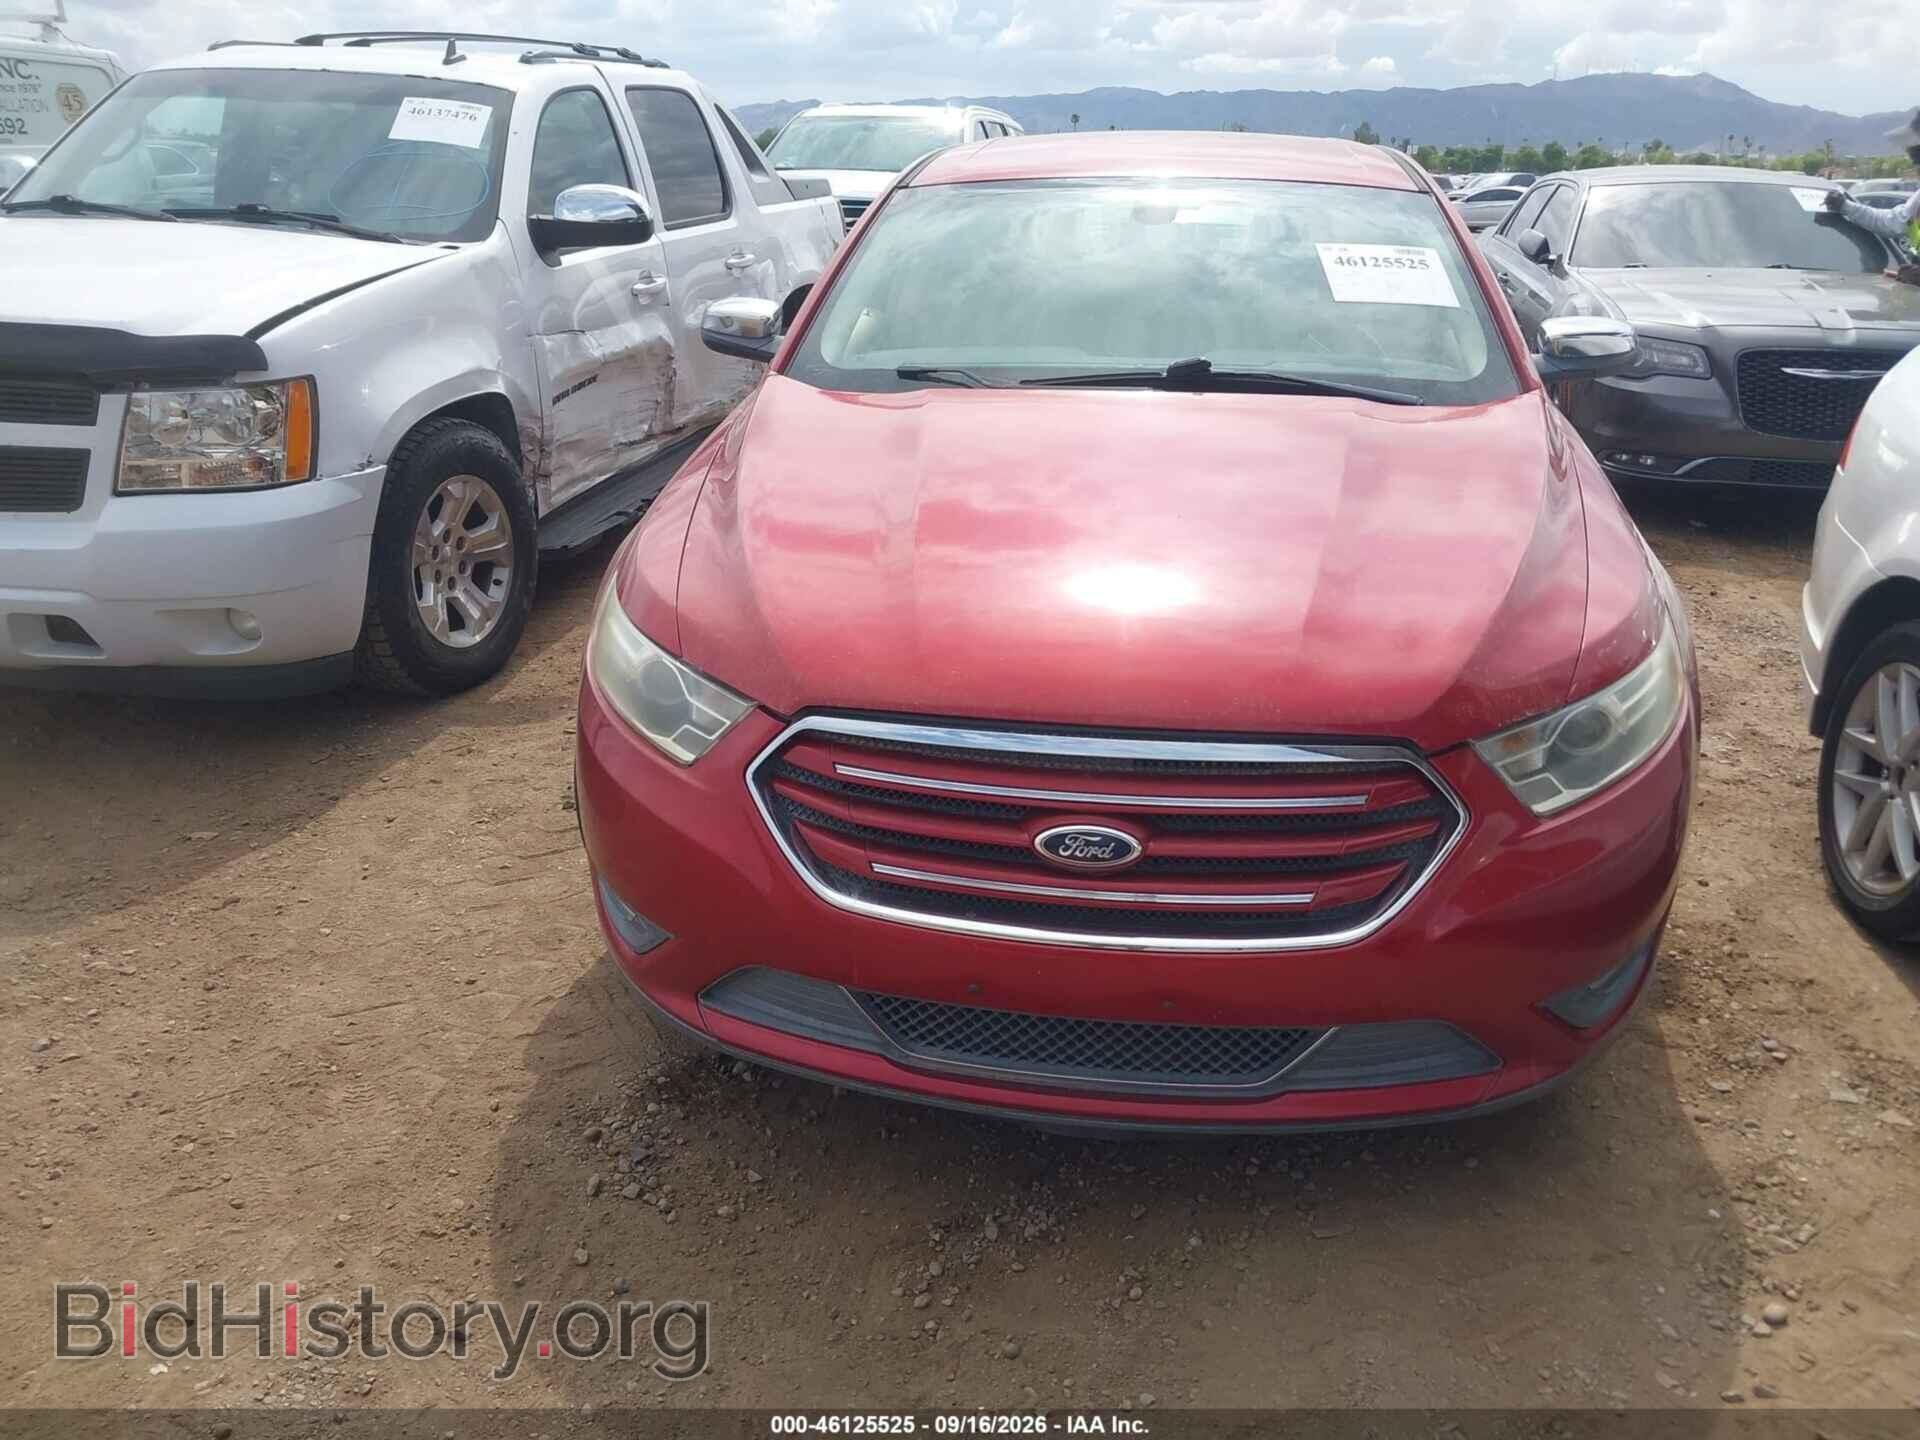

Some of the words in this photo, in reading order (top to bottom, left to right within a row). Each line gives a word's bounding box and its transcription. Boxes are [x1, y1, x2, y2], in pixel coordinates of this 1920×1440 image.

[63, 94, 82, 111] 45
[408, 107, 478, 121] 46137476
[1333, 255, 1431, 271] 46125525
[1059, 834, 1115, 859] Ford
